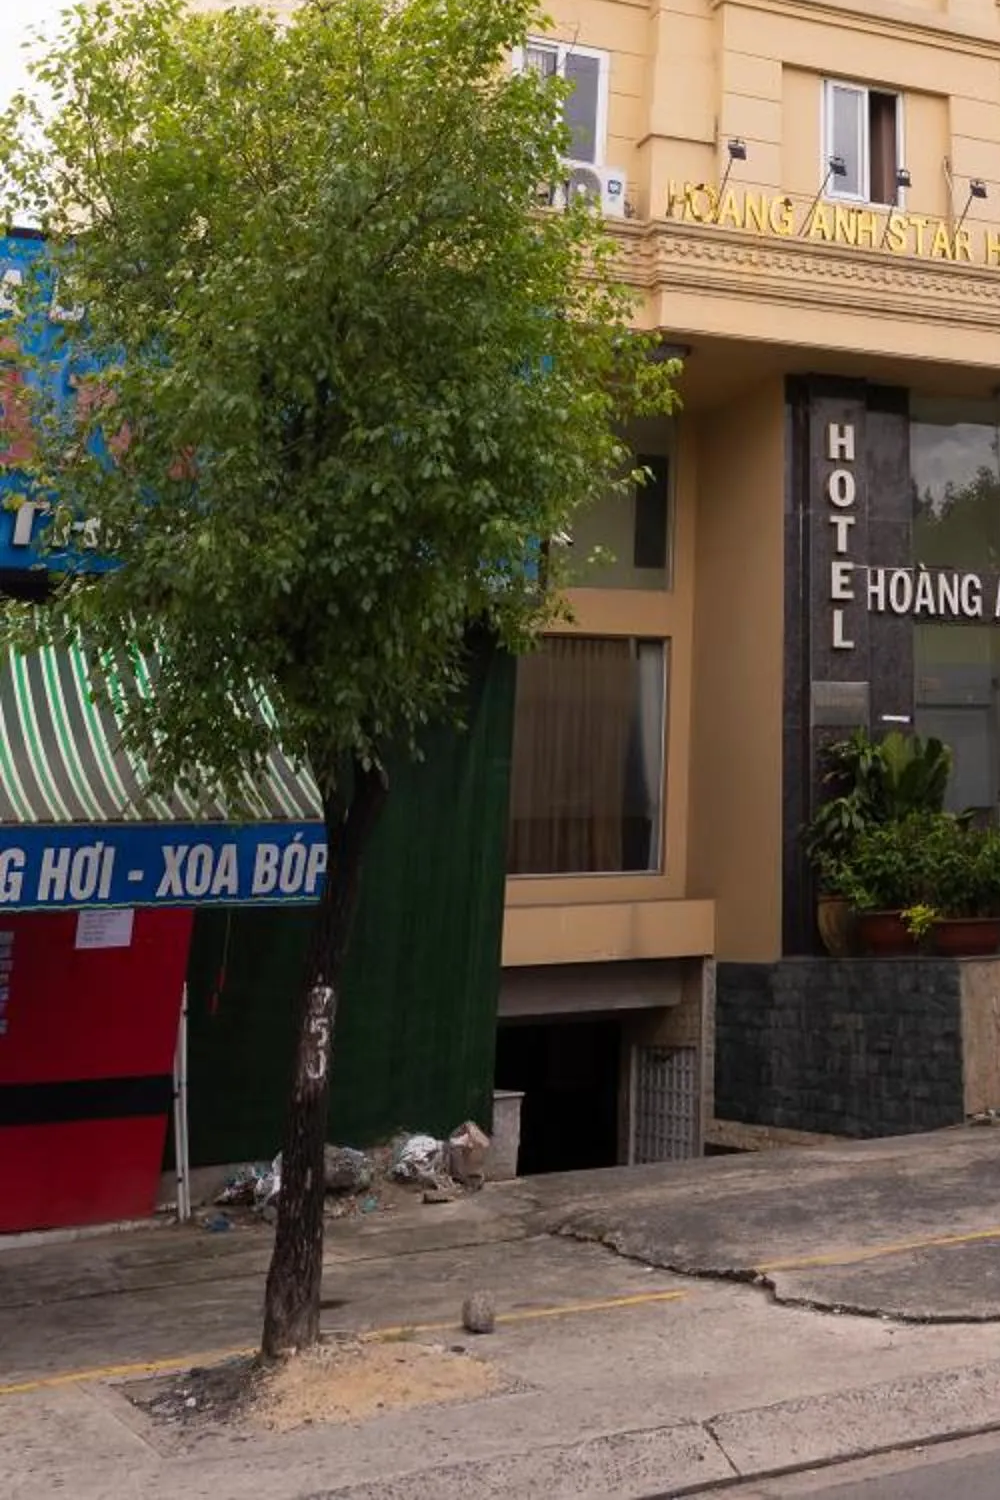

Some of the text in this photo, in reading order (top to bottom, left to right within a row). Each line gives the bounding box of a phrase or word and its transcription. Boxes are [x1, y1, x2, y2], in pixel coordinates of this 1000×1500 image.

[808, 207, 878, 247] ANH
[885, 216, 973, 262] STAR
[828, 423, 857, 650] HOTEL
[867, 563, 983, 617] HOÀNG
[37, 841, 115, 901] HƠI
[156, 843, 240, 897] XOA
[252, 832, 328, 895] BÓP
